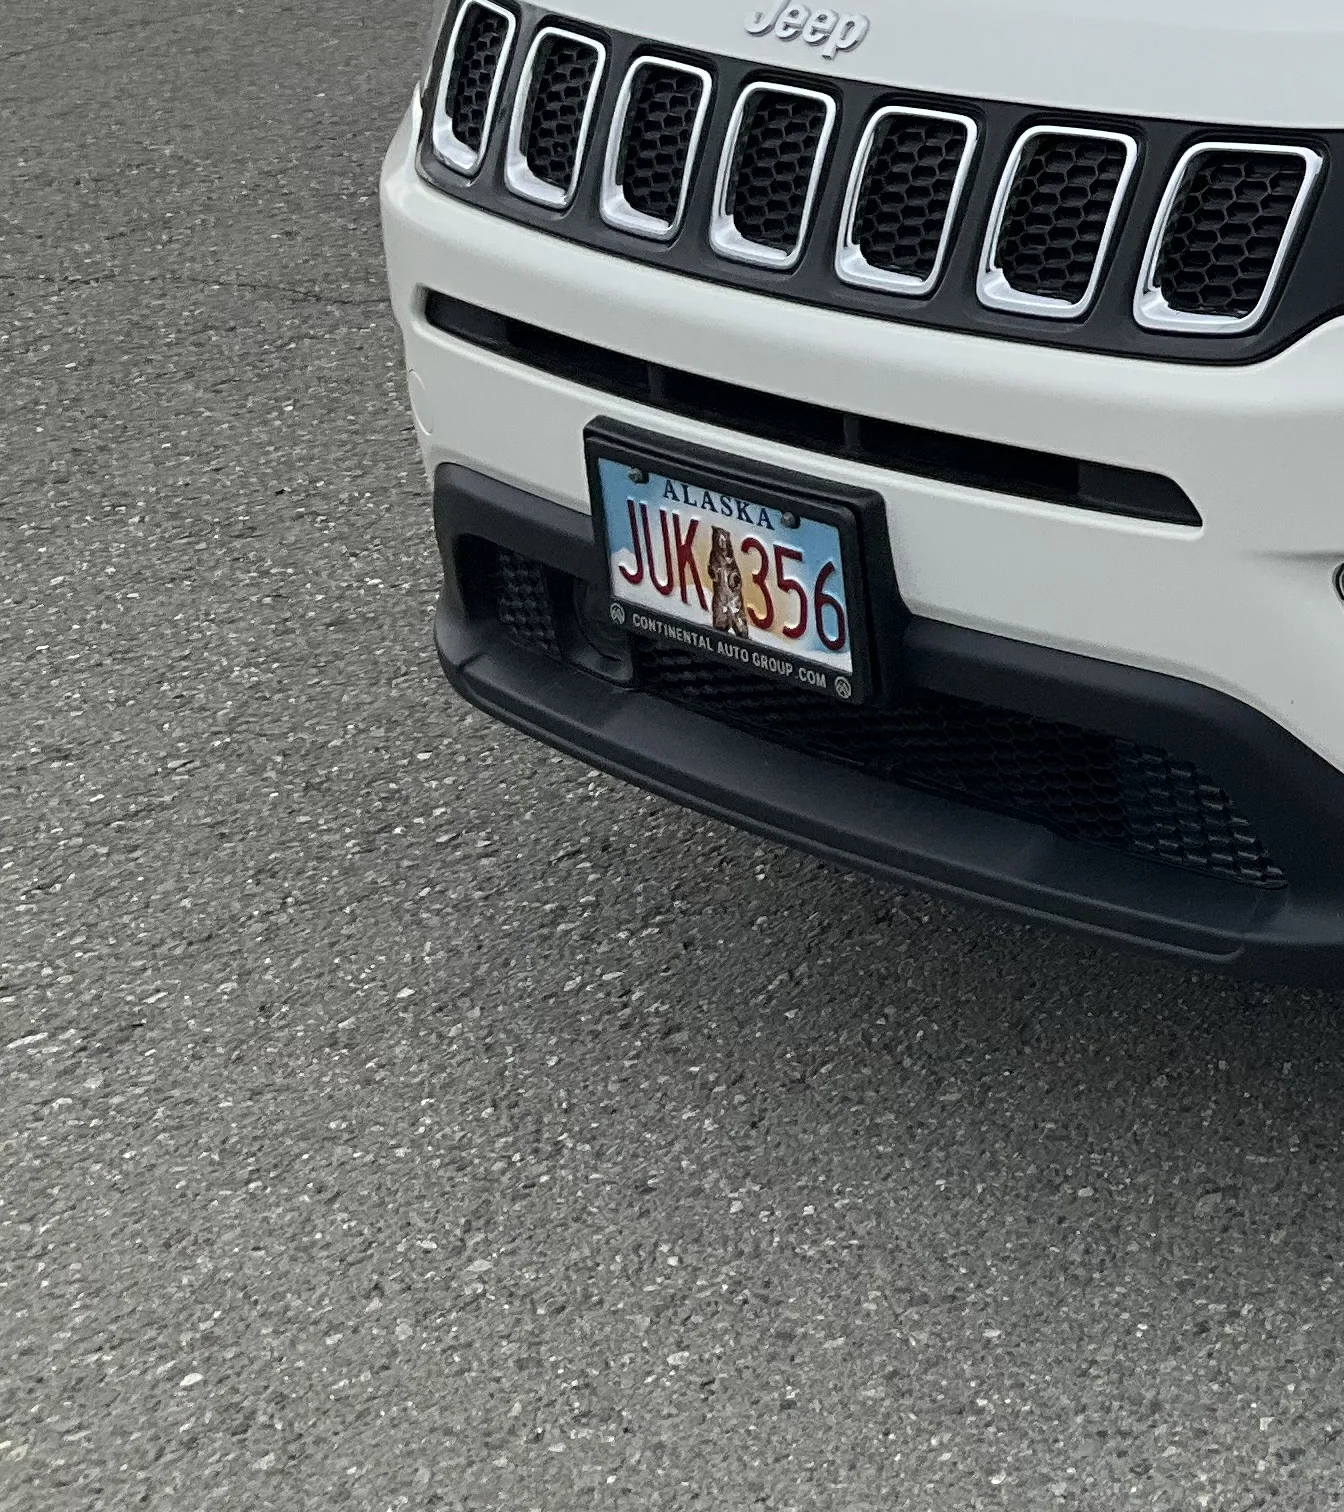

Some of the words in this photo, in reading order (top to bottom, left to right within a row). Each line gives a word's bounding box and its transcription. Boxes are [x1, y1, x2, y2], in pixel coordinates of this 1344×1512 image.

[663, 479, 775, 531] ALASKA
[618, 498, 709, 612] JUK
[740, 537, 848, 651] 356
[632, 613, 714, 652] CONTINENTAL
[717, 641, 749, 663] AUTO
[752, 651, 793, 677] GROUP
